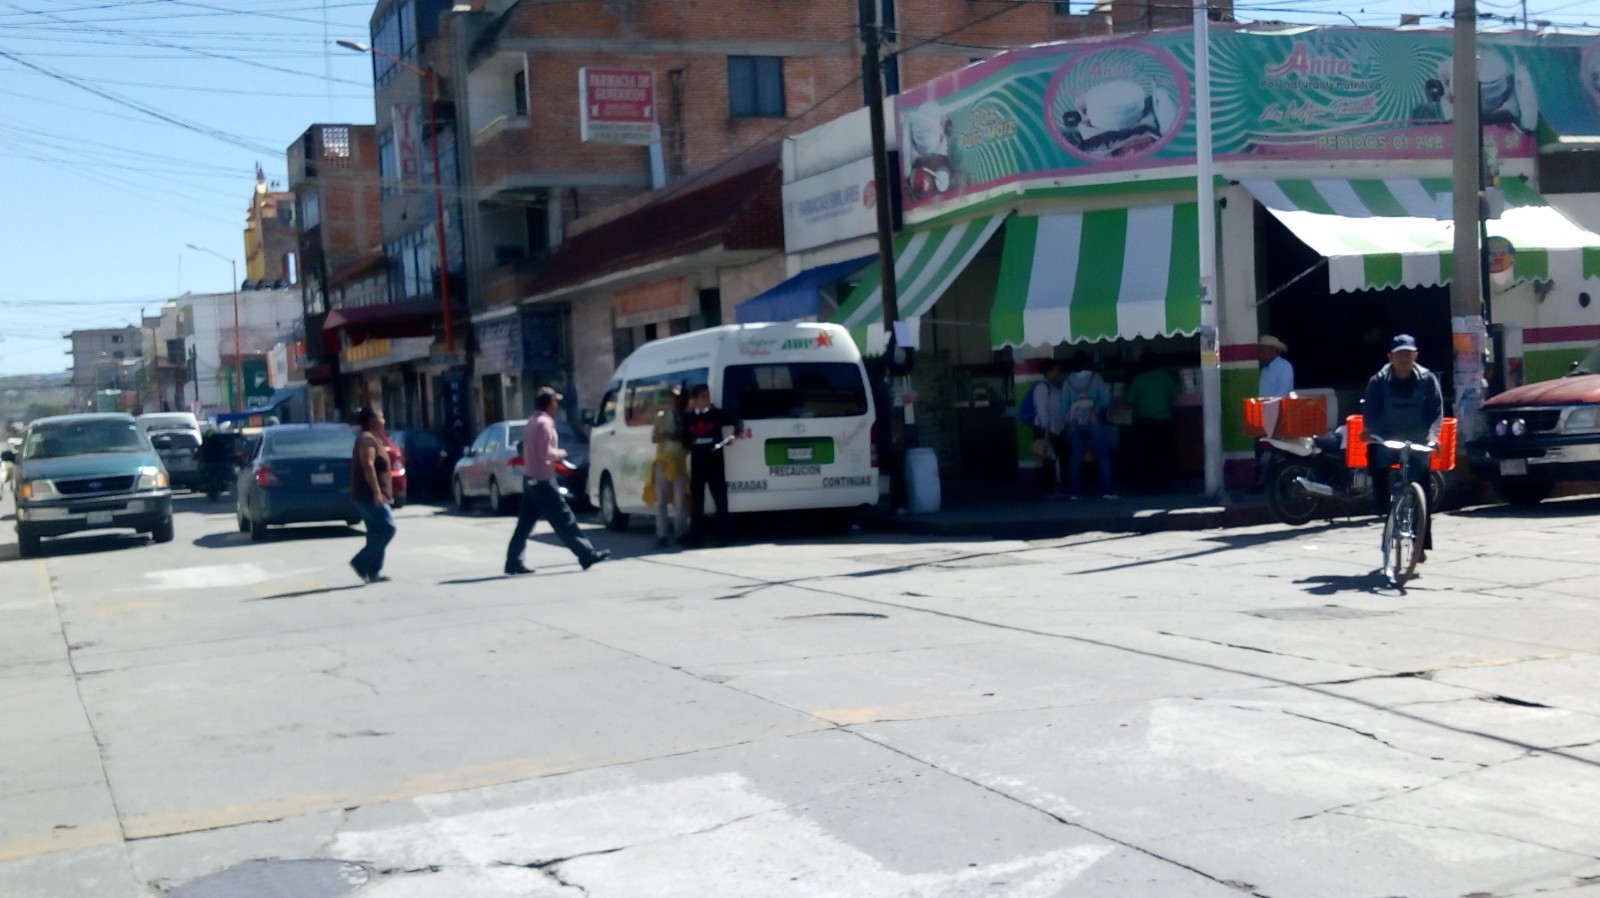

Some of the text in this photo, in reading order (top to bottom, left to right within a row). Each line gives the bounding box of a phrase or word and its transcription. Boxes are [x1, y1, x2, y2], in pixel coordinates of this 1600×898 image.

[1264, 40, 1351, 78] Anita
[1318, 135, 1387, 150] PEDIDOS
[769, 465, 821, 476] PRECAUCION
[822, 476, 871, 487] CONTINUAS
